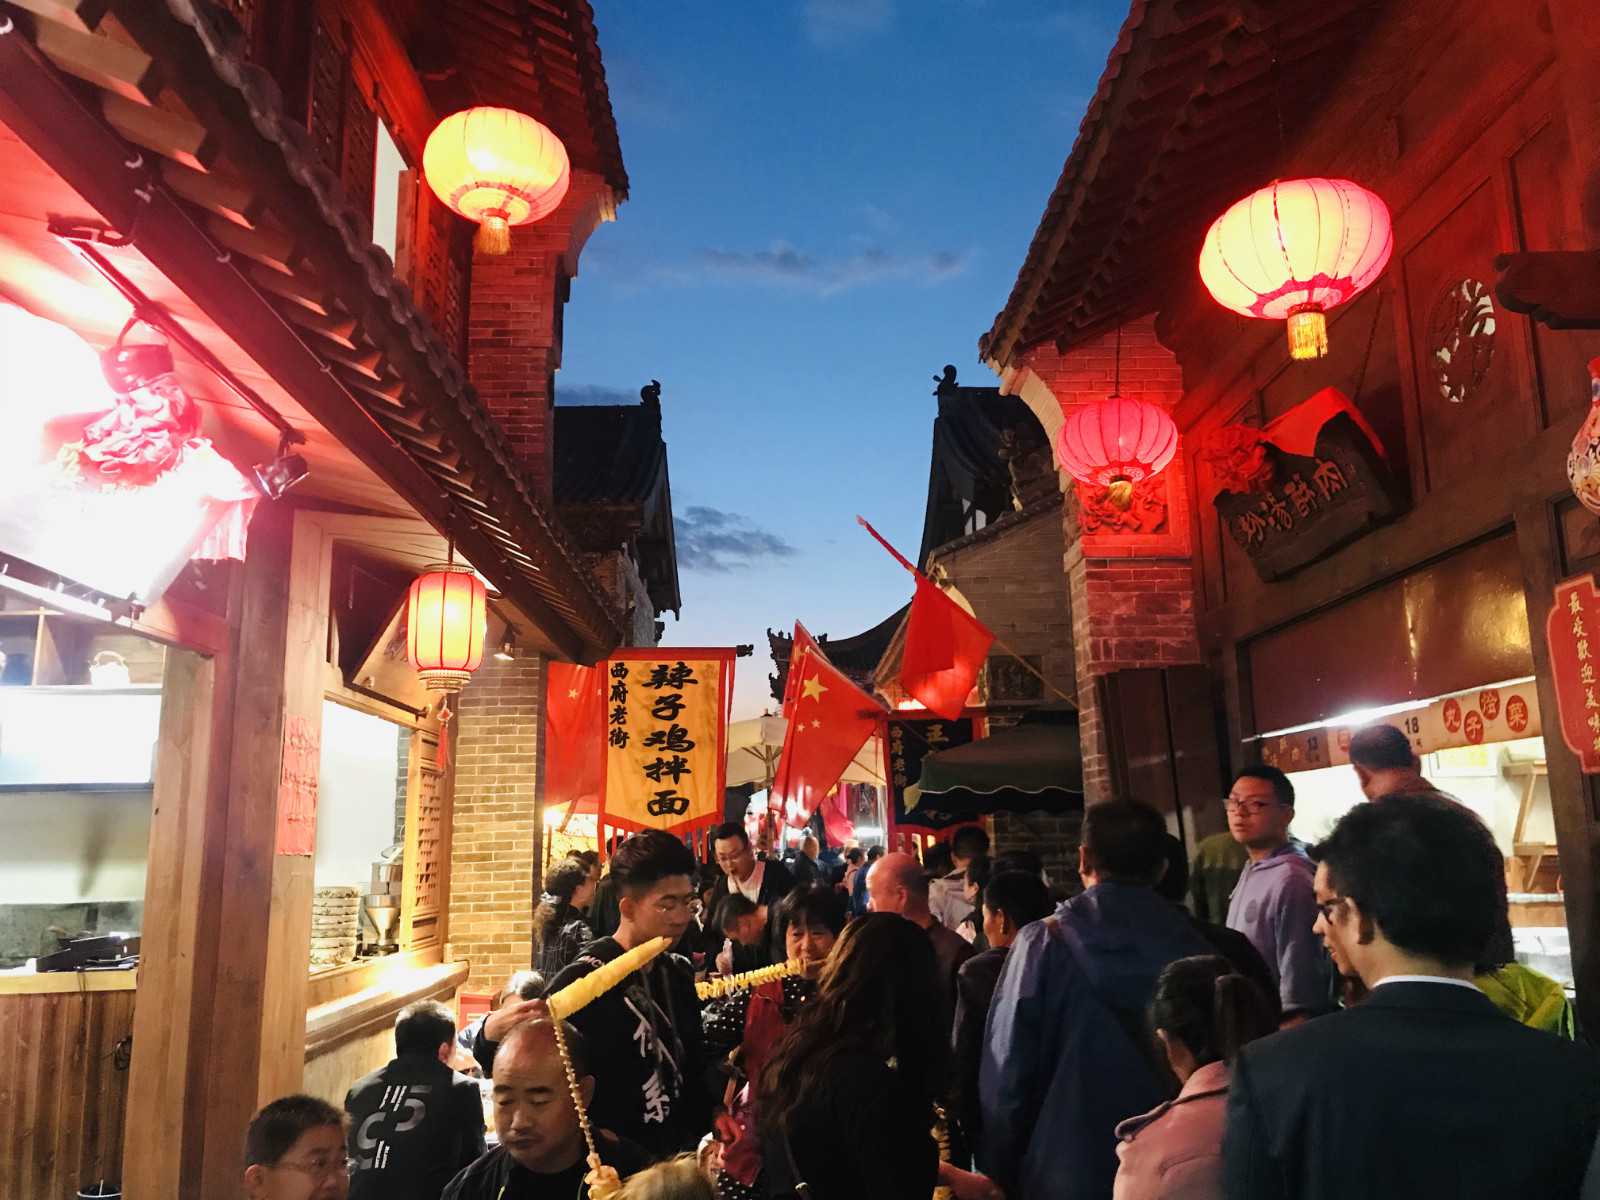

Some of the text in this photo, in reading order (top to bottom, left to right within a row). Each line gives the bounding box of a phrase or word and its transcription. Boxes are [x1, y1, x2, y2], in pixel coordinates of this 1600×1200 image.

[642, 661, 698, 816] 辣子鸡拌面
[1404, 717, 1419, 734] 18
